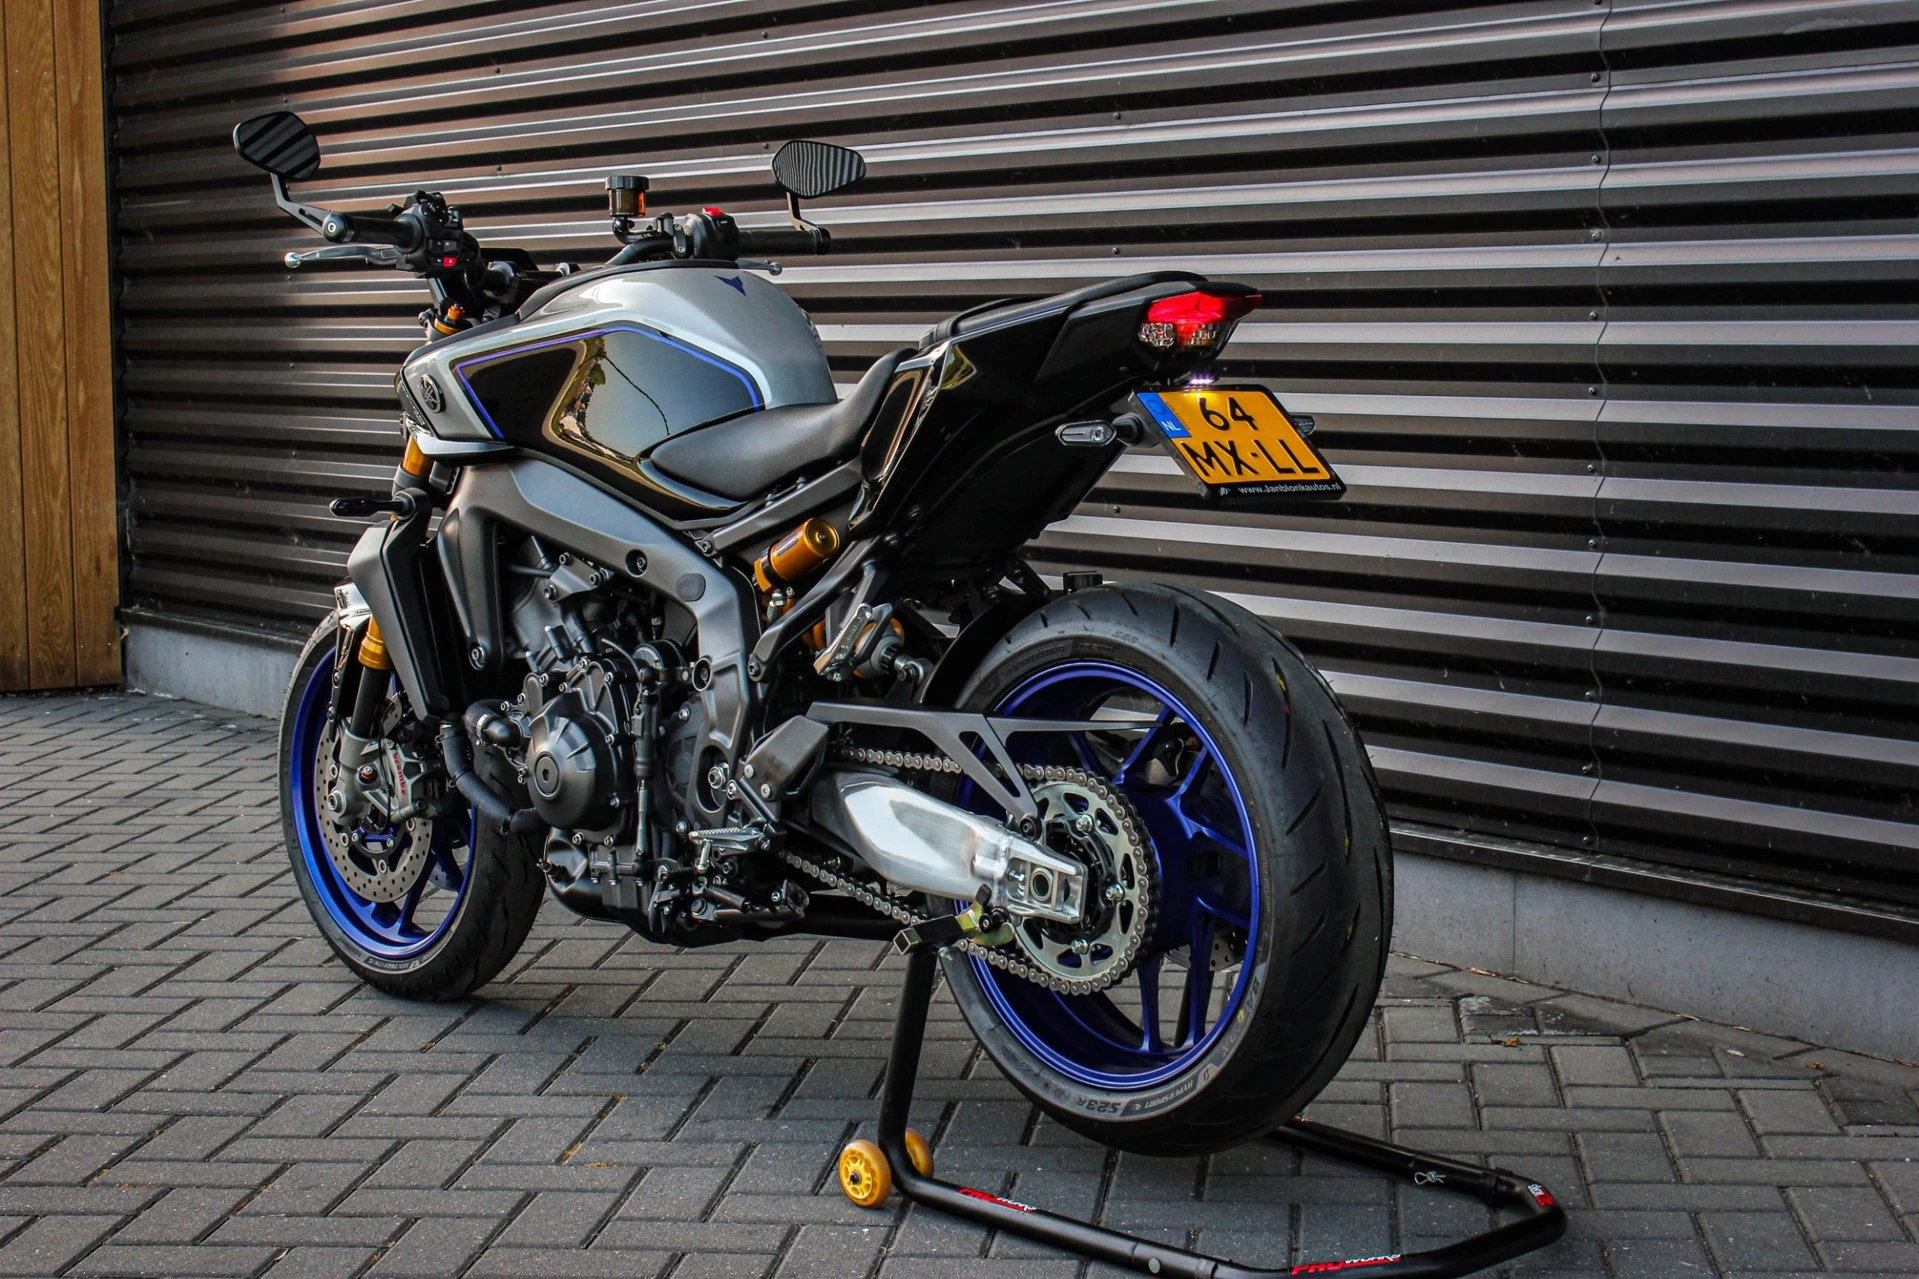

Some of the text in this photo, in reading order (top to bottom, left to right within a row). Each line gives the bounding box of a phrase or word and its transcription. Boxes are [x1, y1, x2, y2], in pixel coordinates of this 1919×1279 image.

[1161, 420, 1182, 432] NL
[1199, 397, 1258, 431] 64
[393, 752, 407, 797] brembo
[1144, 1078, 1194, 1109] HYPERSPORT
